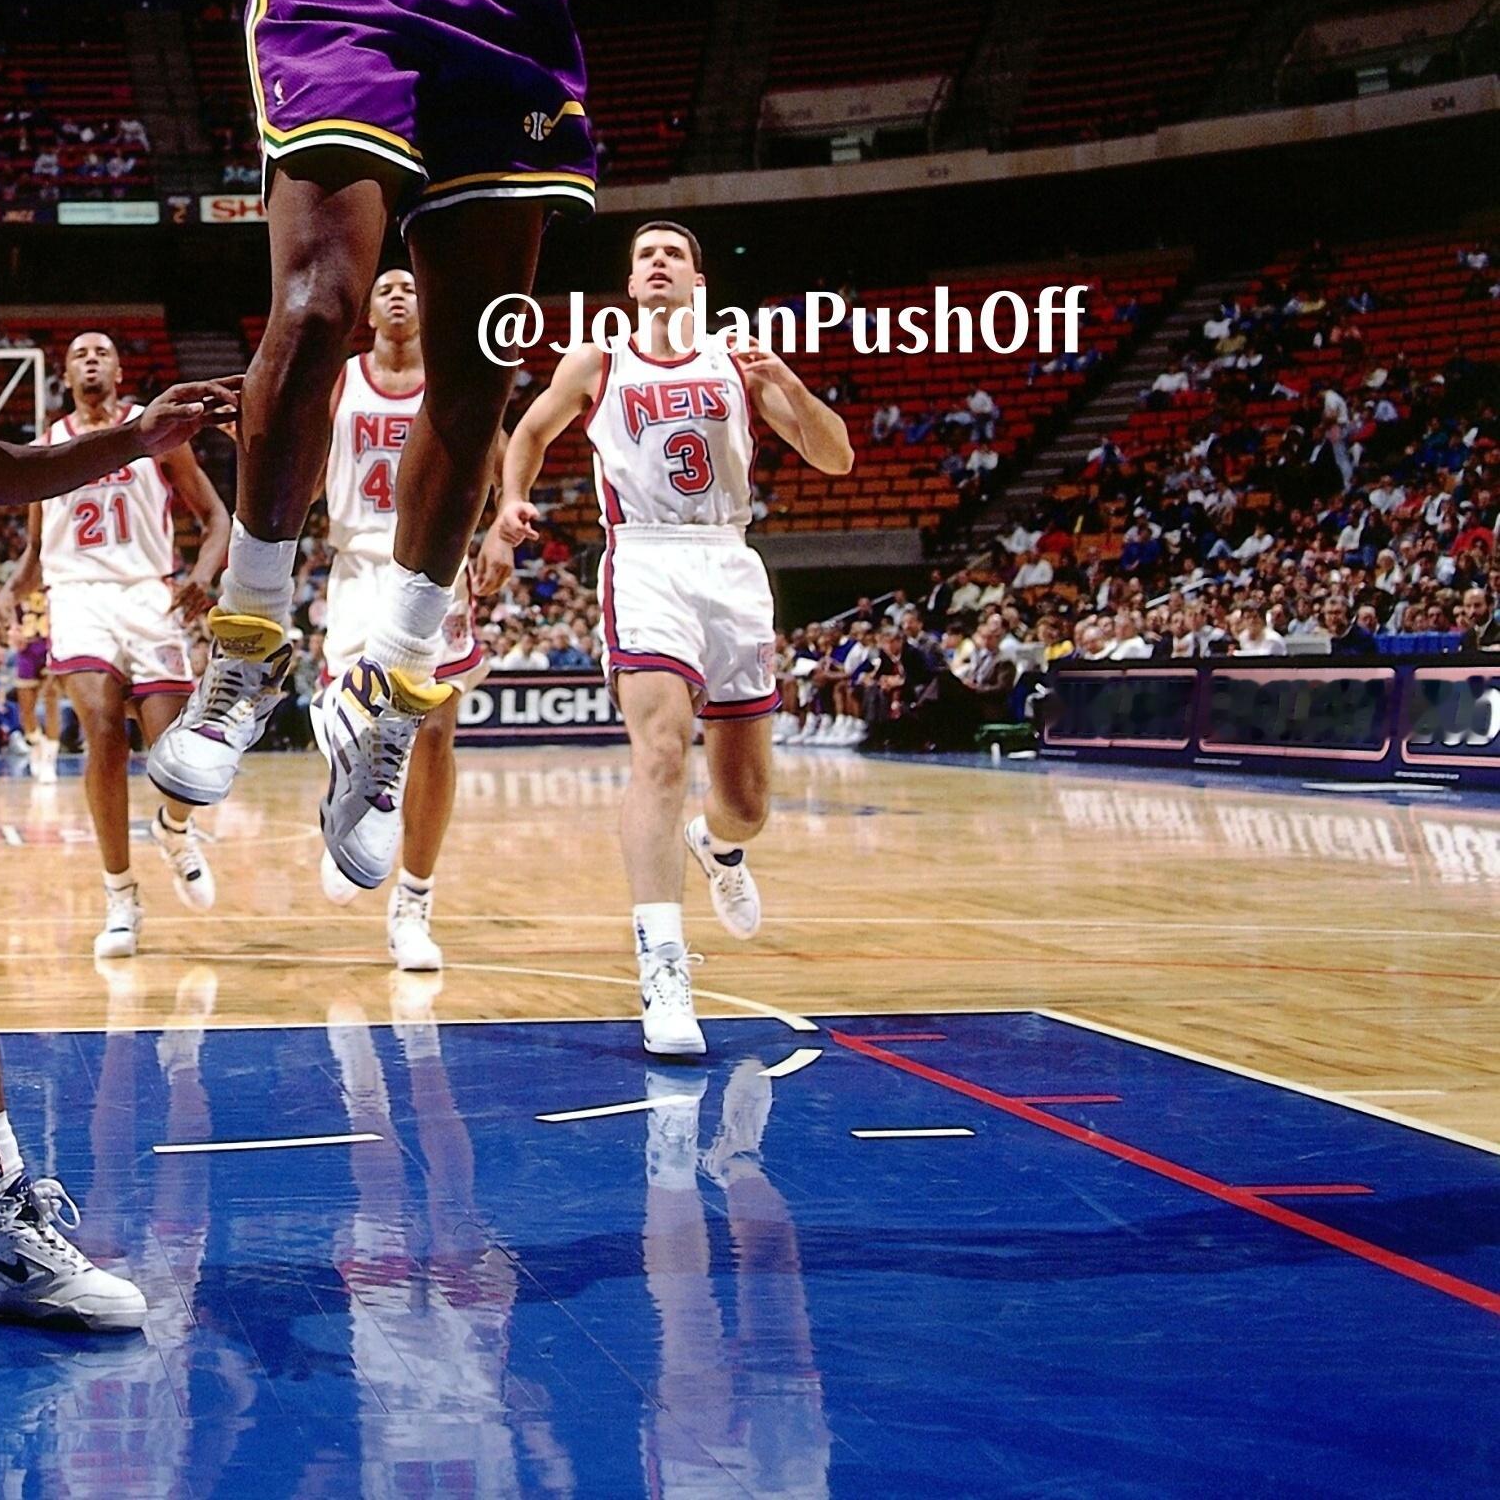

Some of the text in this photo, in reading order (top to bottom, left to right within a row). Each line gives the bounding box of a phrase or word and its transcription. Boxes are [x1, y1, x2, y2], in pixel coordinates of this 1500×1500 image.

[212, 200, 264, 220] SH
[351, 412, 415, 463] NE
[620, 379, 731, 444] NETS
[359, 459, 396, 513] 4
[664, 430, 714, 496] 3
[72, 493, 132, 550] 21
[456, 687, 626, 725] D LIGH
